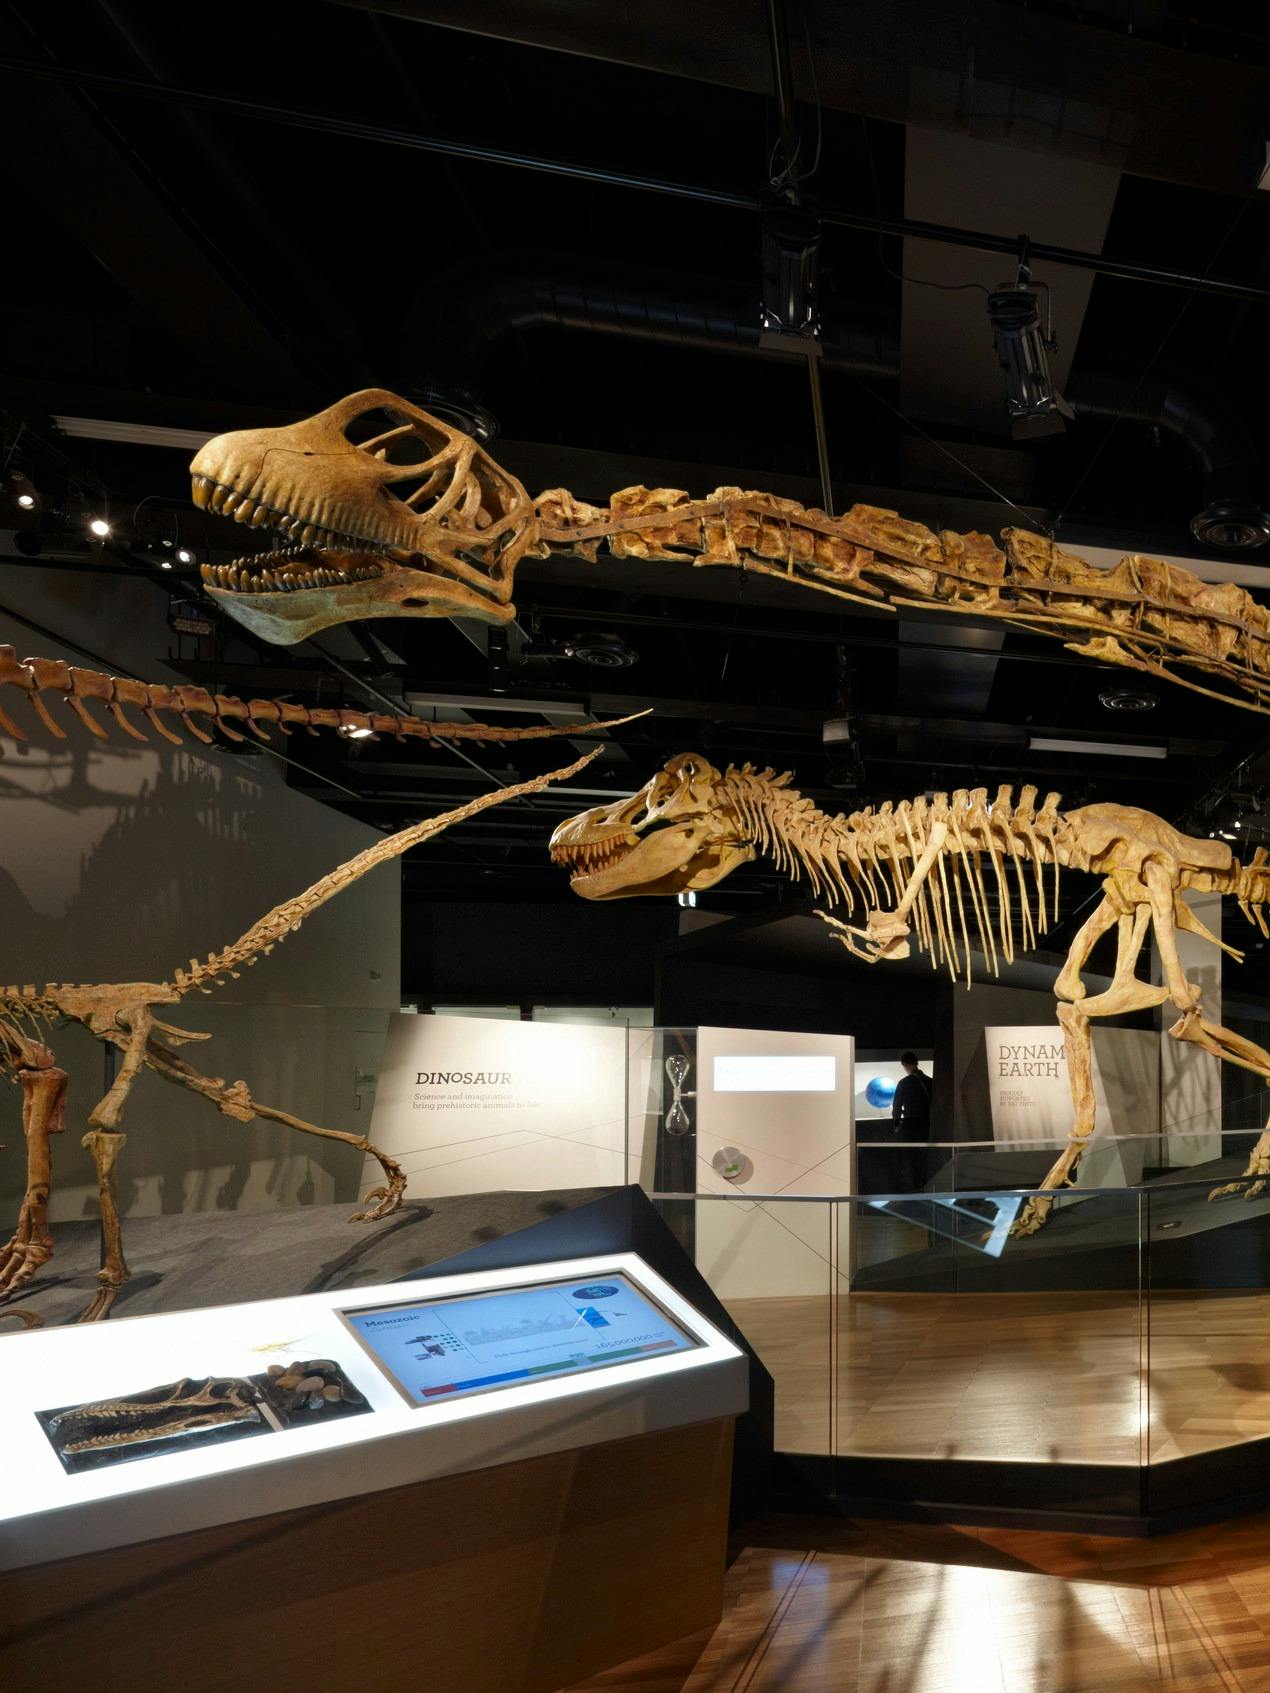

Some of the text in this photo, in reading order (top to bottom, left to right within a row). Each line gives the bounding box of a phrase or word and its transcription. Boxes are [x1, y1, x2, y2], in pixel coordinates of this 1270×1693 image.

[999, 1045, 1066, 1060] DYNAM
[999, 1062, 1059, 1077] EARTH
[415, 1072, 512, 1085] DINOSAUR
[414, 1093, 446, 1101] Science
[447, 1092, 463, 1101] and
[412, 1101, 436, 1111] bring
[436, 1101, 482, 1112] prehistoric
